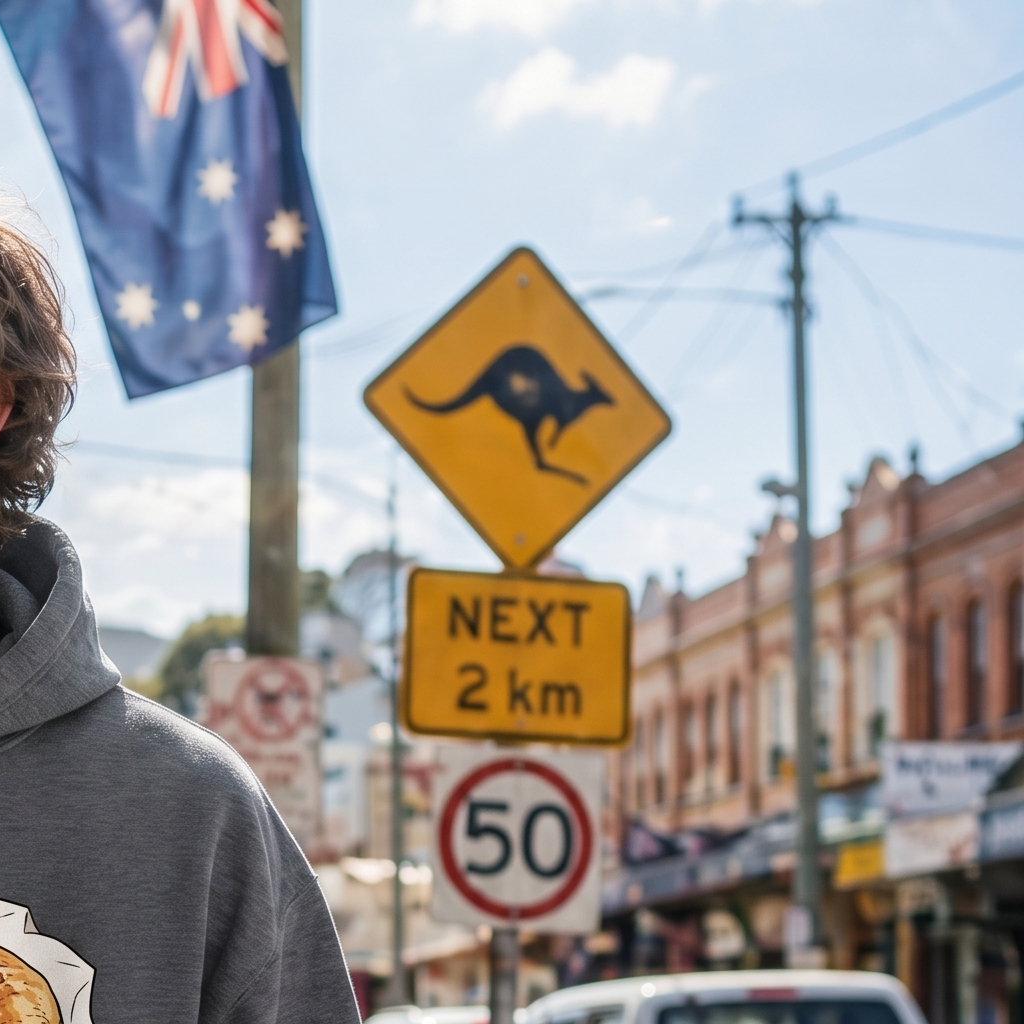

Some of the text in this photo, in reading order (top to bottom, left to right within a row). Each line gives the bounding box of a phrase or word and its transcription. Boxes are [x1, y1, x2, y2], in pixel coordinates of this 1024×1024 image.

[447, 594, 592, 647] NEXT
[455, 662, 584, 718] 2 km
[465, 800, 574, 880] 50
